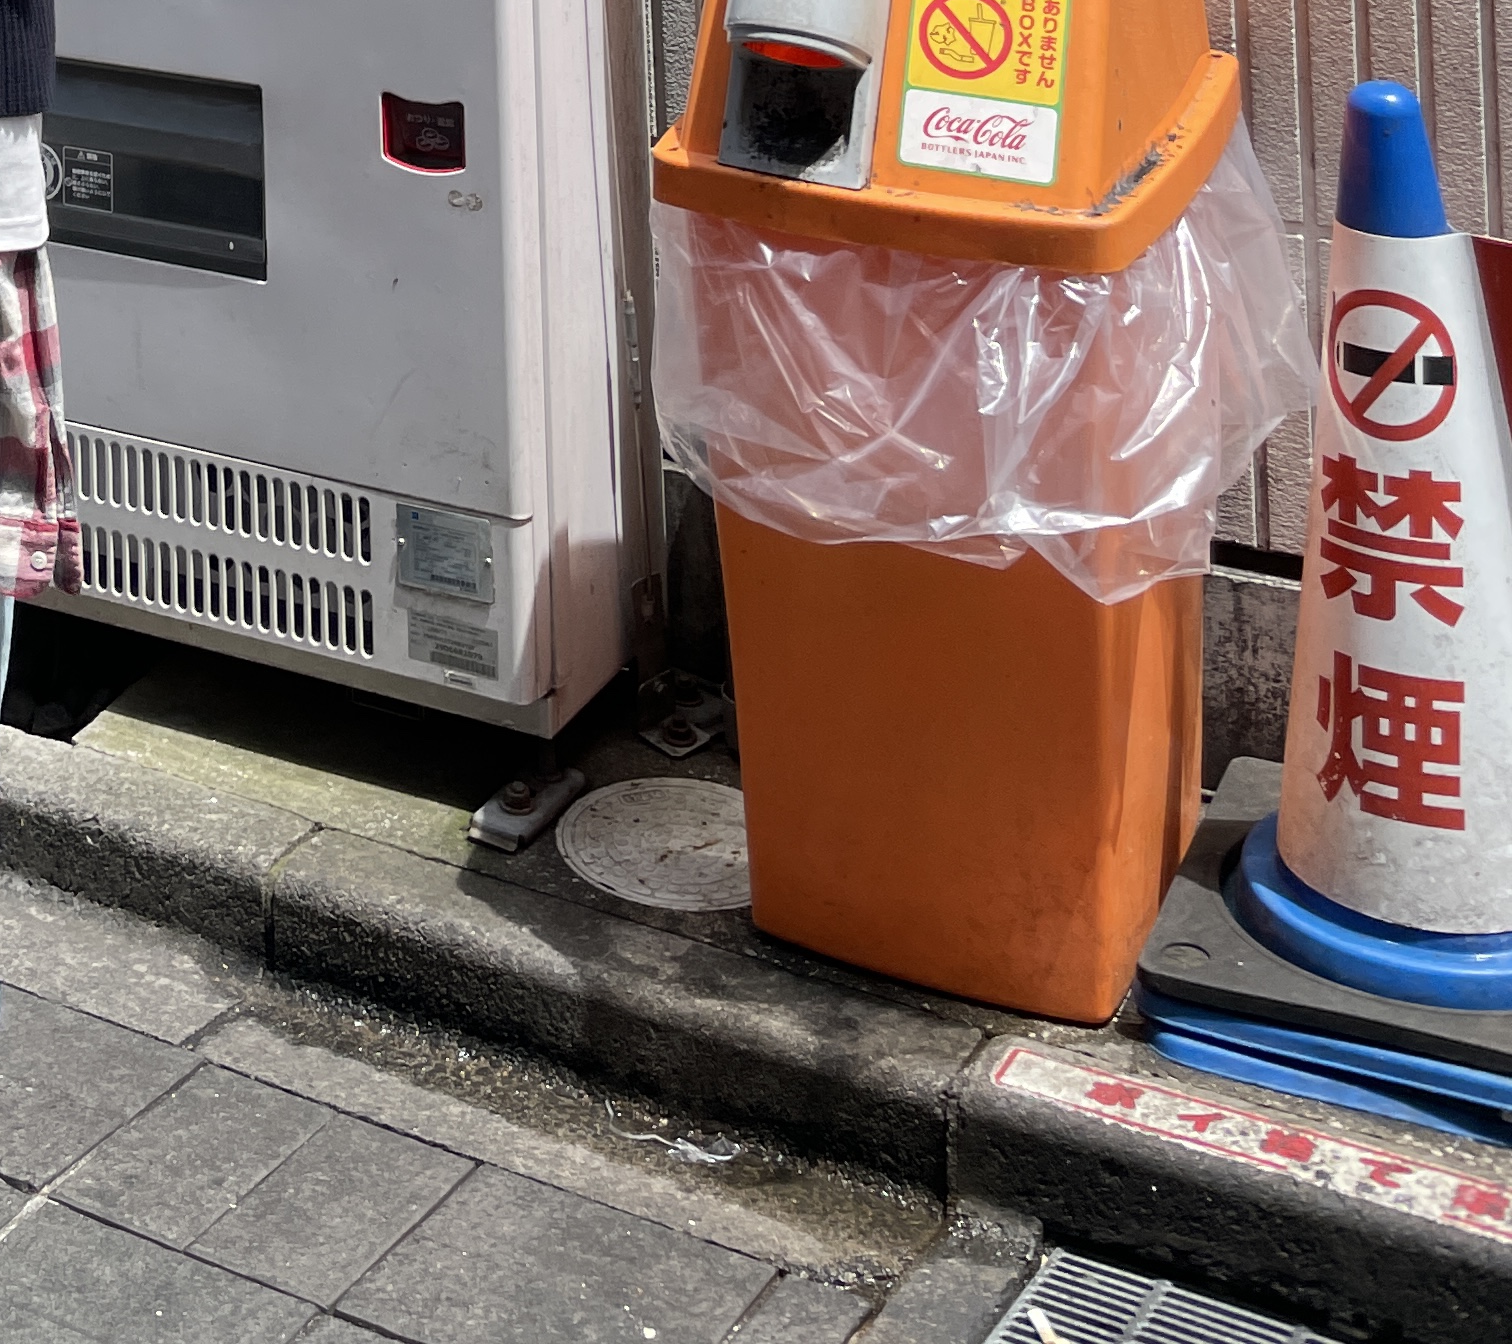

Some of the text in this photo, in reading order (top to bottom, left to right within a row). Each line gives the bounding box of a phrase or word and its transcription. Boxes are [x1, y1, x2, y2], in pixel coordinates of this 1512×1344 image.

[922, 106, 1035, 150] Coca-Cola
[921, 142, 972, 157] BOTTLERS
[974, 149, 1005, 162] JAPAN
[1316, 451, 1467, 832] 禁煙
